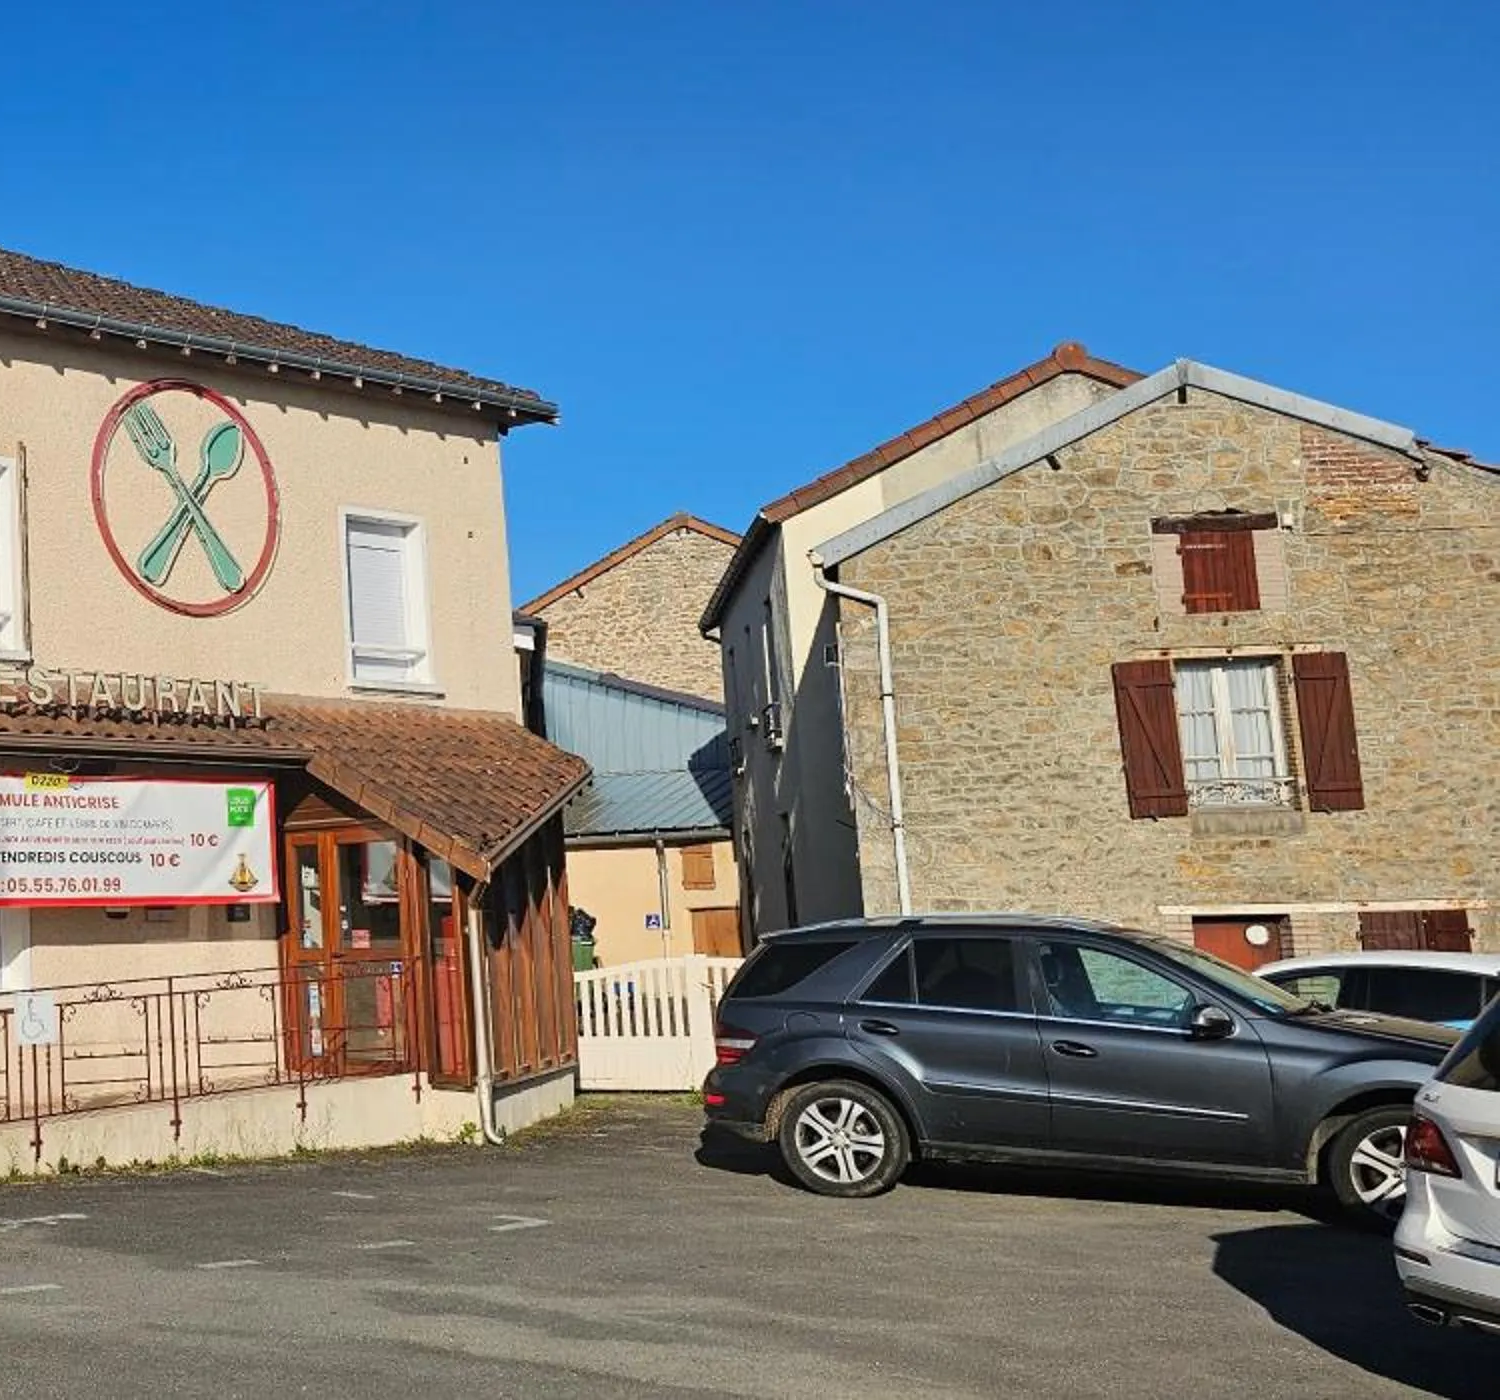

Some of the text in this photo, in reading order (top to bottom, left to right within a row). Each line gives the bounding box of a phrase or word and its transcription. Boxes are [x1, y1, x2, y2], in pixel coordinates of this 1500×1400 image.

[43, 796, 120, 809] ANTICRISE
[190, 833, 205, 847] 10
[208, 833, 220, 847] €
[69, 851, 142, 864] COUSCOUS
[150, 853, 165, 868] 10
[169, 854, 181, 867] €
